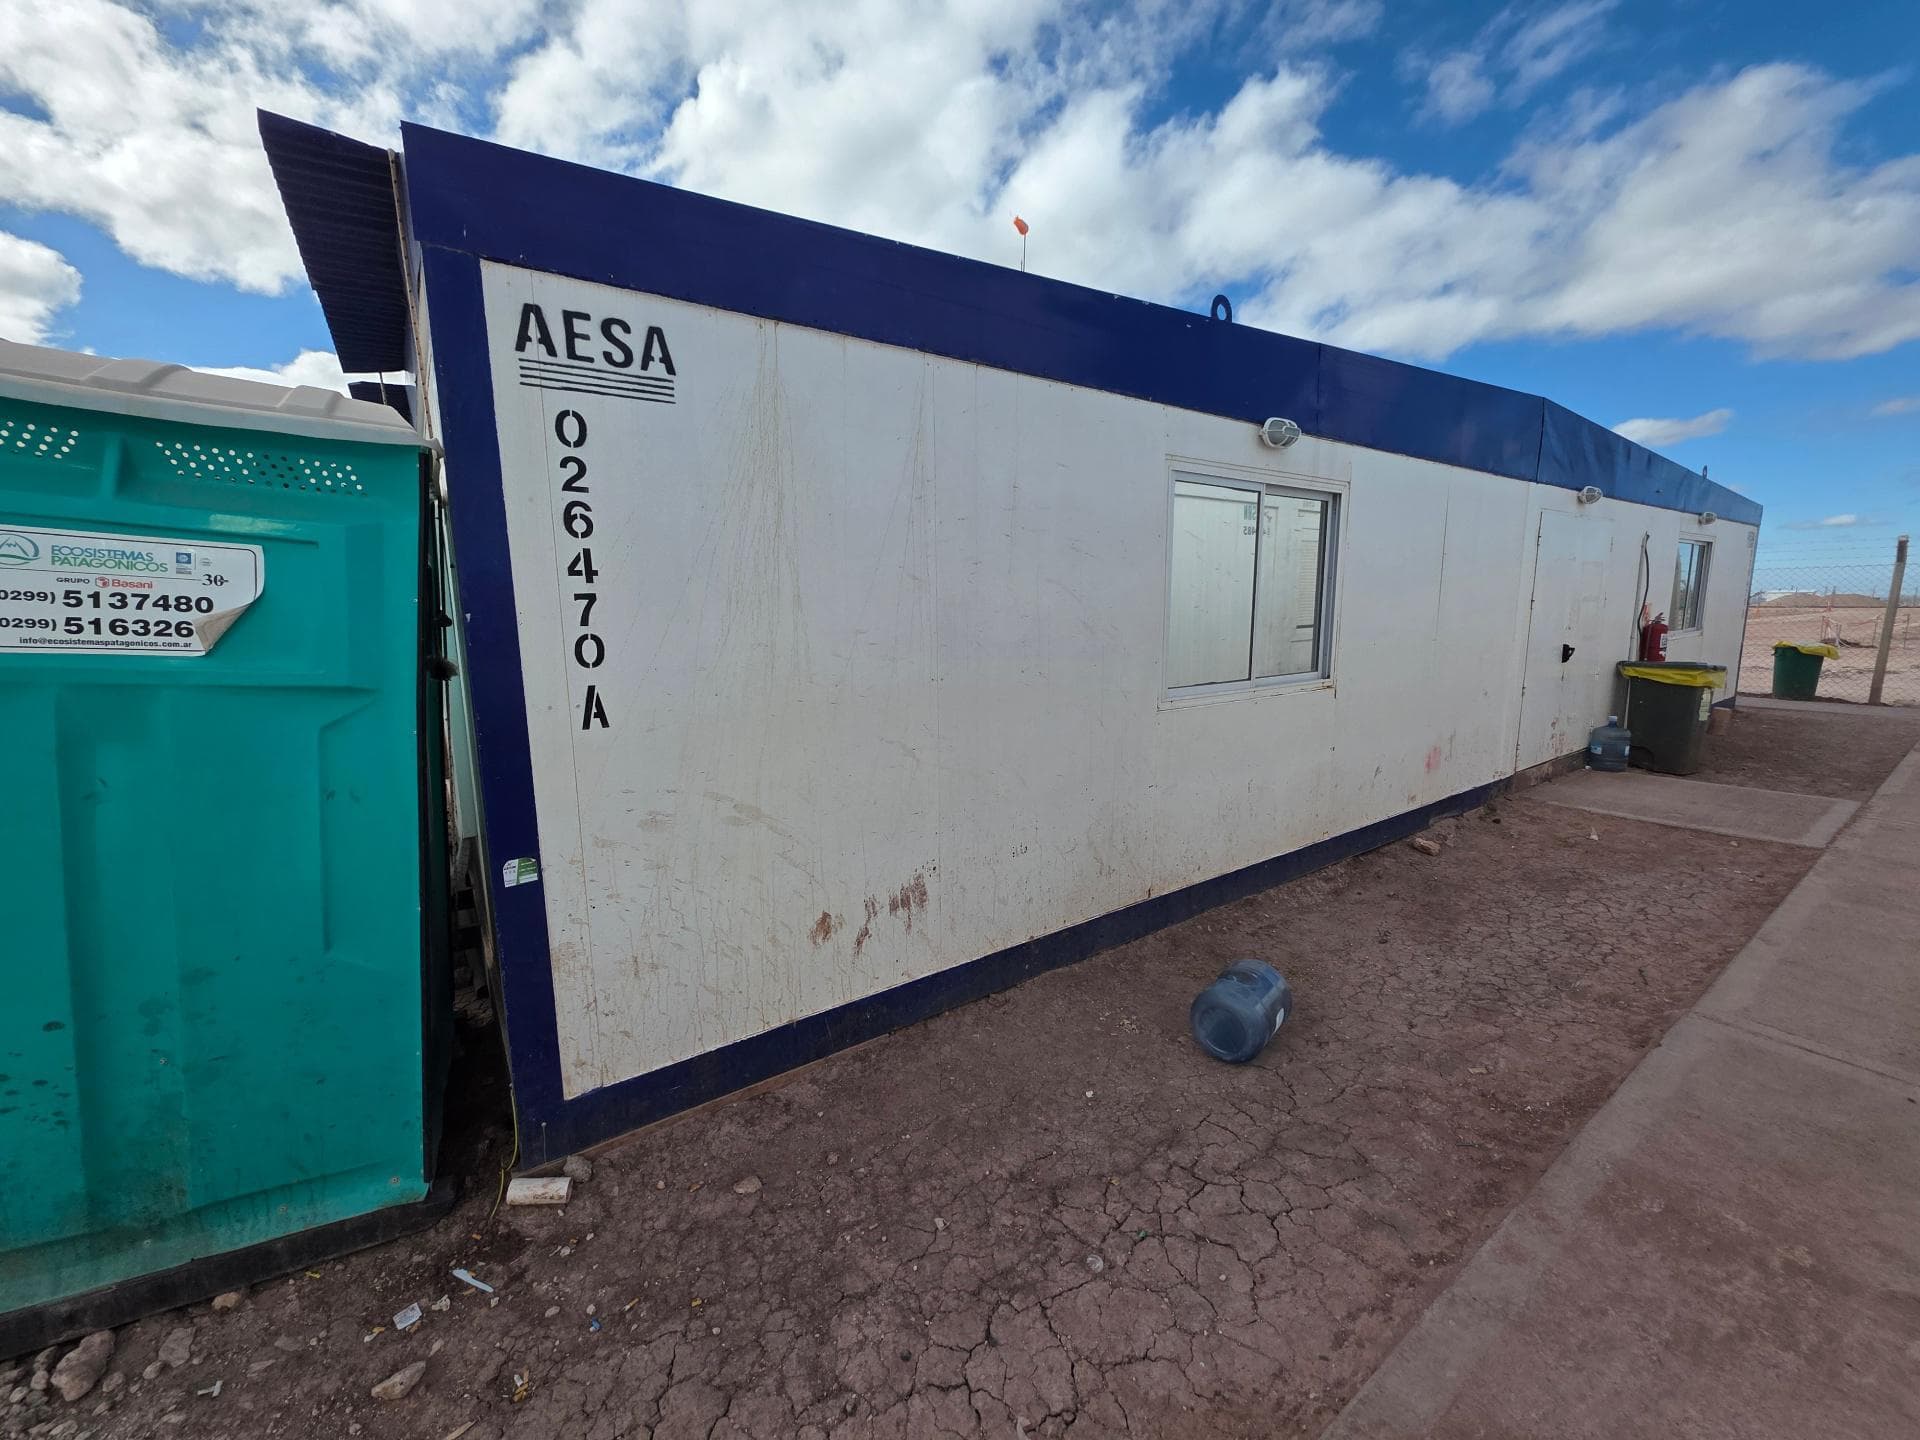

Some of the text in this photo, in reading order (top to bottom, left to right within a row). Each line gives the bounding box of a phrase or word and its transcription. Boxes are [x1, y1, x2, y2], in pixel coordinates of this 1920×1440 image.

[515, 303, 676, 376] AESA
[51, 545, 154, 561] ECOSISTEMAS
[51, 556, 168, 572] PATAGONICOS
[55, 577, 153, 589] GRUPO Basani
[62, 590, 214, 613] 5137480
[63, 617, 194, 638] 516326
[19, 637, 192, 648] info@ecosistemaspatagonicos.com.ar
